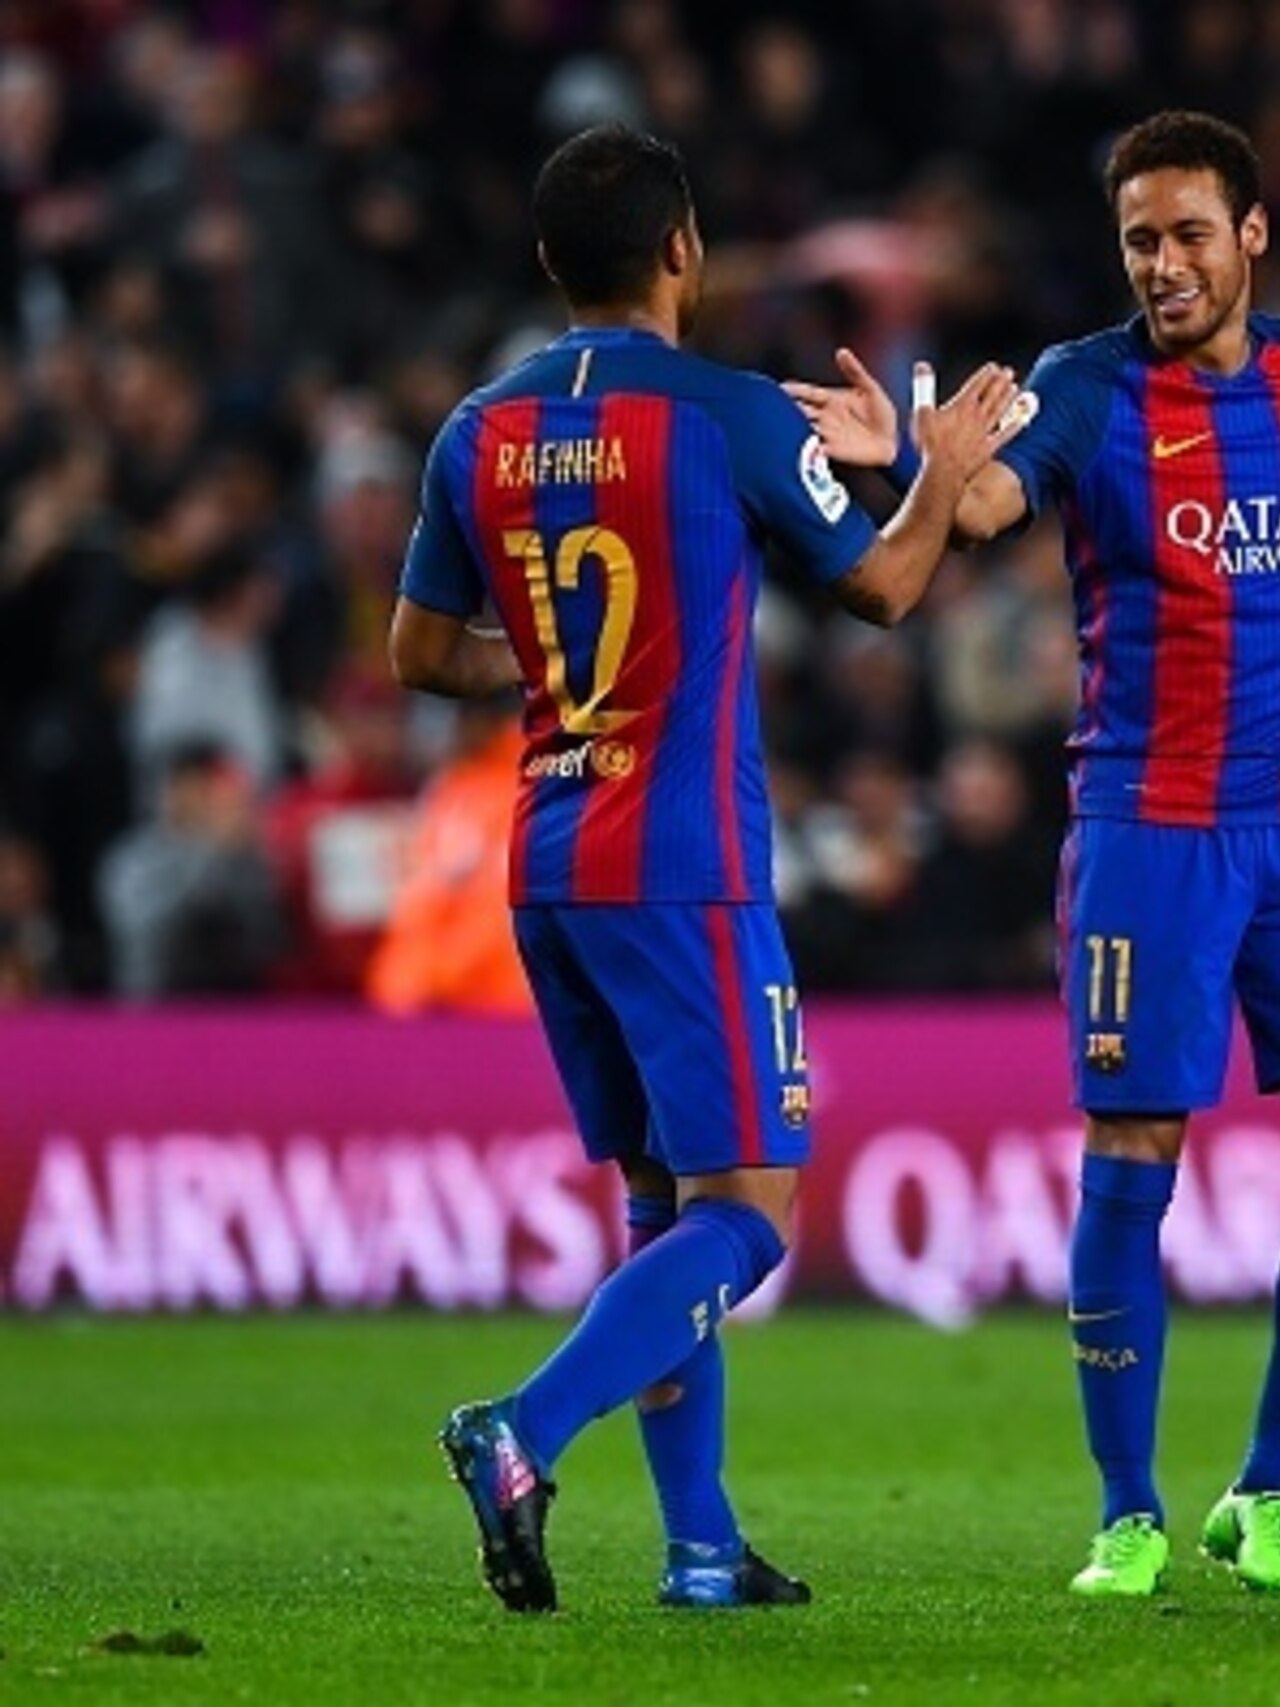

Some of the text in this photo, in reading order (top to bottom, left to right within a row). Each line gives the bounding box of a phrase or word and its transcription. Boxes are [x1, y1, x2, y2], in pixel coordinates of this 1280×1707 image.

[495, 437, 627, 488] RAFINHA
[503, 525, 644, 734] 12
[1086, 935, 1131, 1022] 11
[8, 1130, 606, 1312] AIRWAYS
